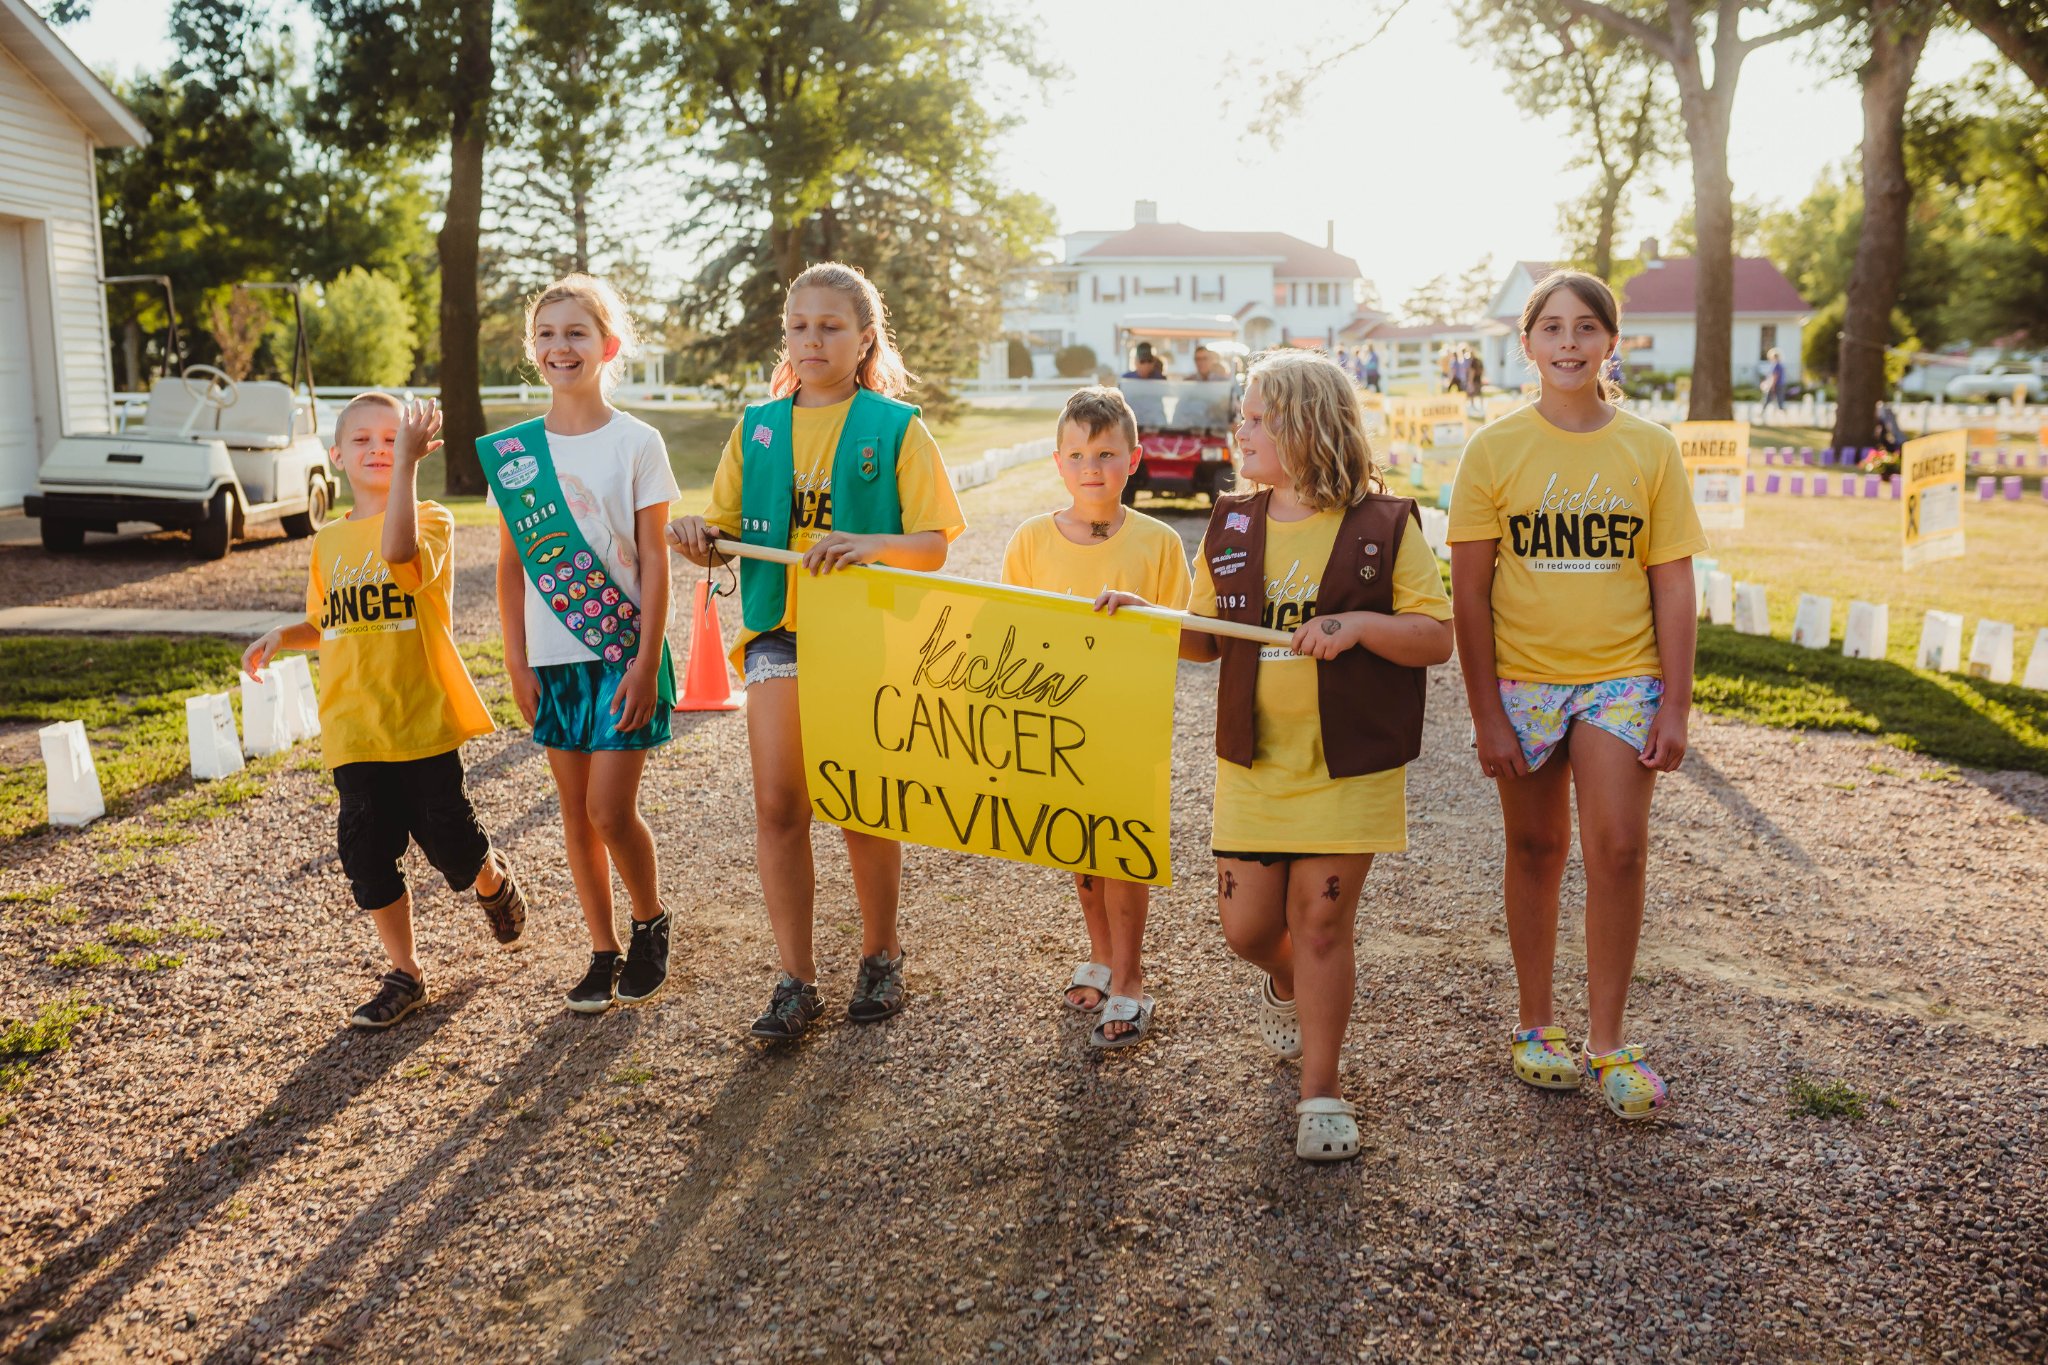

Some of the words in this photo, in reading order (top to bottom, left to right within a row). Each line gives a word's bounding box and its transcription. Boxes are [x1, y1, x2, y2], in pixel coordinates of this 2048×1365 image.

[1681, 440, 1737, 457] CANCER
[1911, 452, 1956, 482] CANCER
[1537, 472, 1638, 519] kickin'
[517, 502, 557, 533] 18519
[1534, 560, 1545, 570] in
[1547, 561, 1591, 570] redwood
[1594, 562, 1621, 571] county
[873, 684, 1086, 786] CANCER
